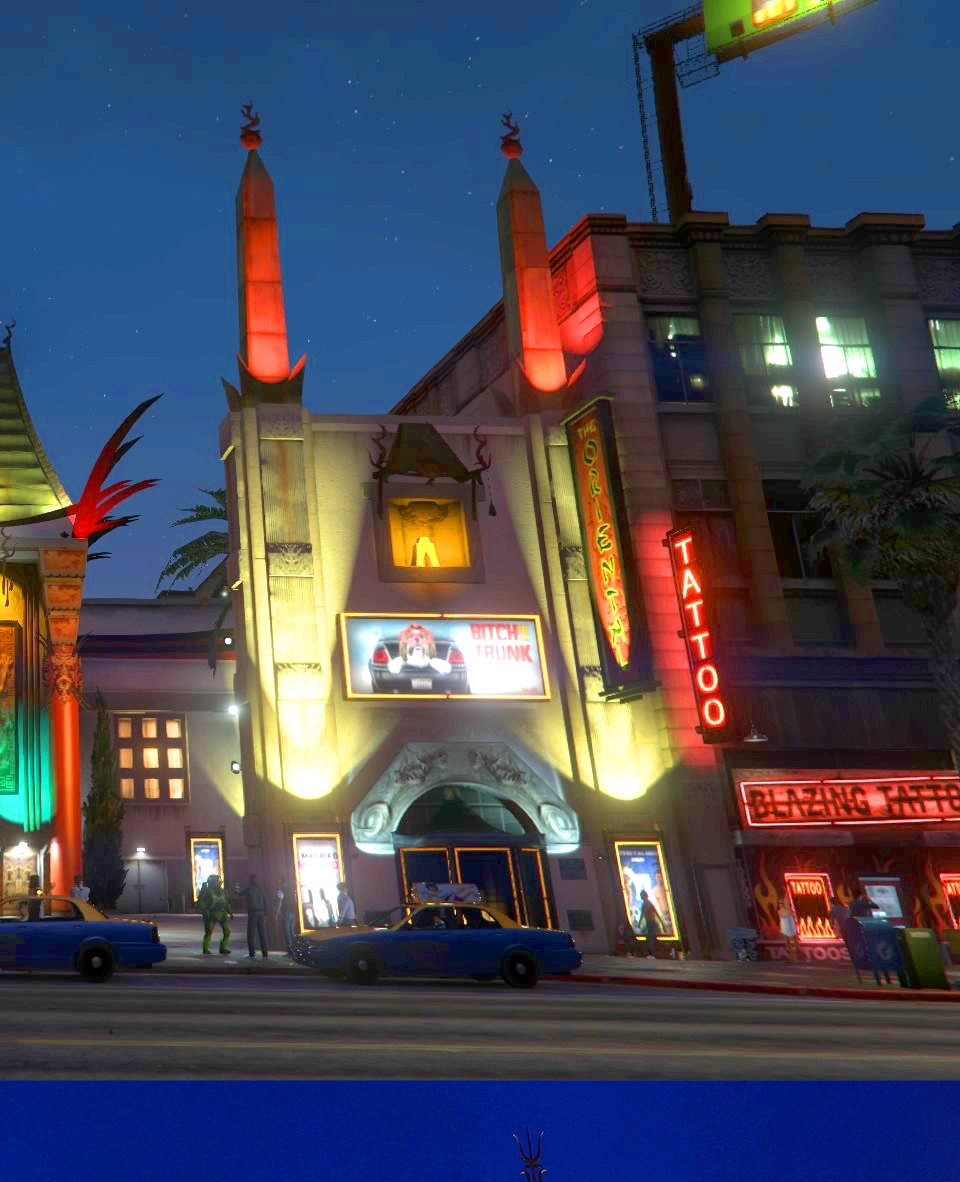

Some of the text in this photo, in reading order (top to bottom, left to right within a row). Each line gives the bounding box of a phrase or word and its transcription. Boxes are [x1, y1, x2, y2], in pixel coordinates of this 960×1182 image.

[470, 623, 518, 641] BITCH
[675, 538, 725, 725] TATTOO
[475, 645, 533, 663] TRUNK
[749, 786, 871, 818] BLAZING
[791, 881, 822, 895] TATTOO
[768, 946, 851, 961] TATOOS
